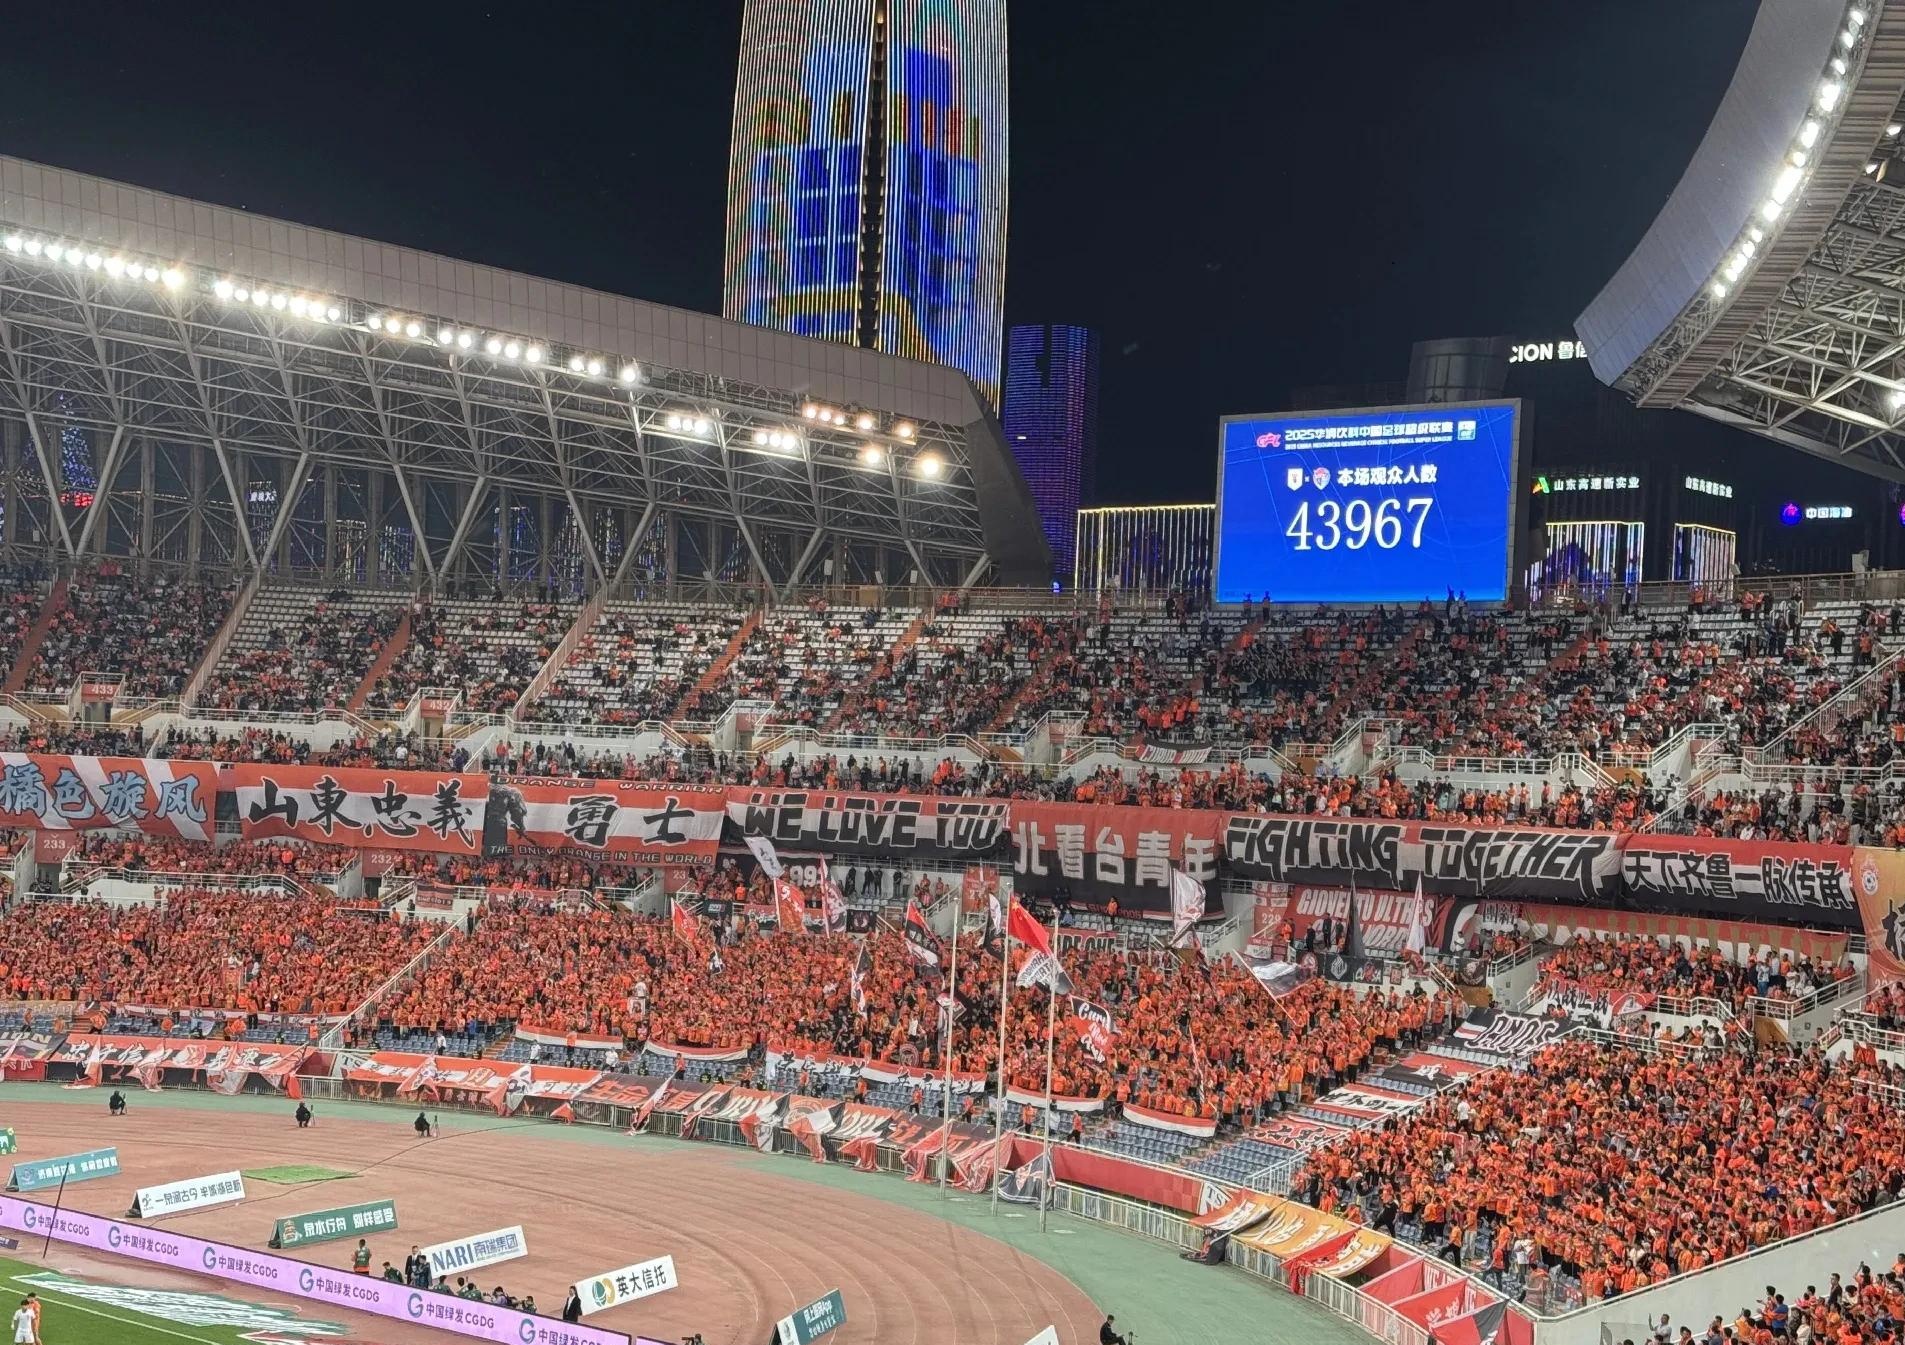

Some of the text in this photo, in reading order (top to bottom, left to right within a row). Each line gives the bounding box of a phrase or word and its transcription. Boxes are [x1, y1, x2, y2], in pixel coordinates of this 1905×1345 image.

[1337, 463, 1438, 487] 本场观众人数
[1285, 497, 1434, 551] 43967
[91, 685, 115, 695] 433
[0, 763, 208, 824] 橘色旋风
[497, 776, 724, 795] ORANGE WARRIOR
[248, 774, 476, 850] 山東忠義
[564, 793, 696, 849] 勇士
[743, 791, 1009, 850] WE LOVE YOU
[43, 839, 66, 850] 233
[489, 844, 514, 856] THE
[557, 847, 611, 862] ORANGE
[613, 852, 628, 863] IN
[633, 852, 661, 864] THE
[665, 853, 713, 866] WORLD
[1012, 820, 1217, 888] 北看台青年
[1224, 816, 1616, 898] FIGHTING TOGETHER
[370, 853, 393, 865] 232
[1624, 848, 1854, 911] 天下齐鲁一脉传承
[37, 1215, 91, 1237] 中国绿发 CGDG
[122, 1235, 179, 1258] 中国绿发 CGDG
[431, 1243, 475, 1273] NARI
[474, 1233, 519, 1258] 南瑞集团
[217, 1255, 278, 1280] 中国绿发 CGDG
[315, 1278, 381, 1303] 中国绿发 CGDG
[615, 1264, 667, 1298] 英大信托
[425, 1302, 495, 1330] 中国绿发 CGDG
